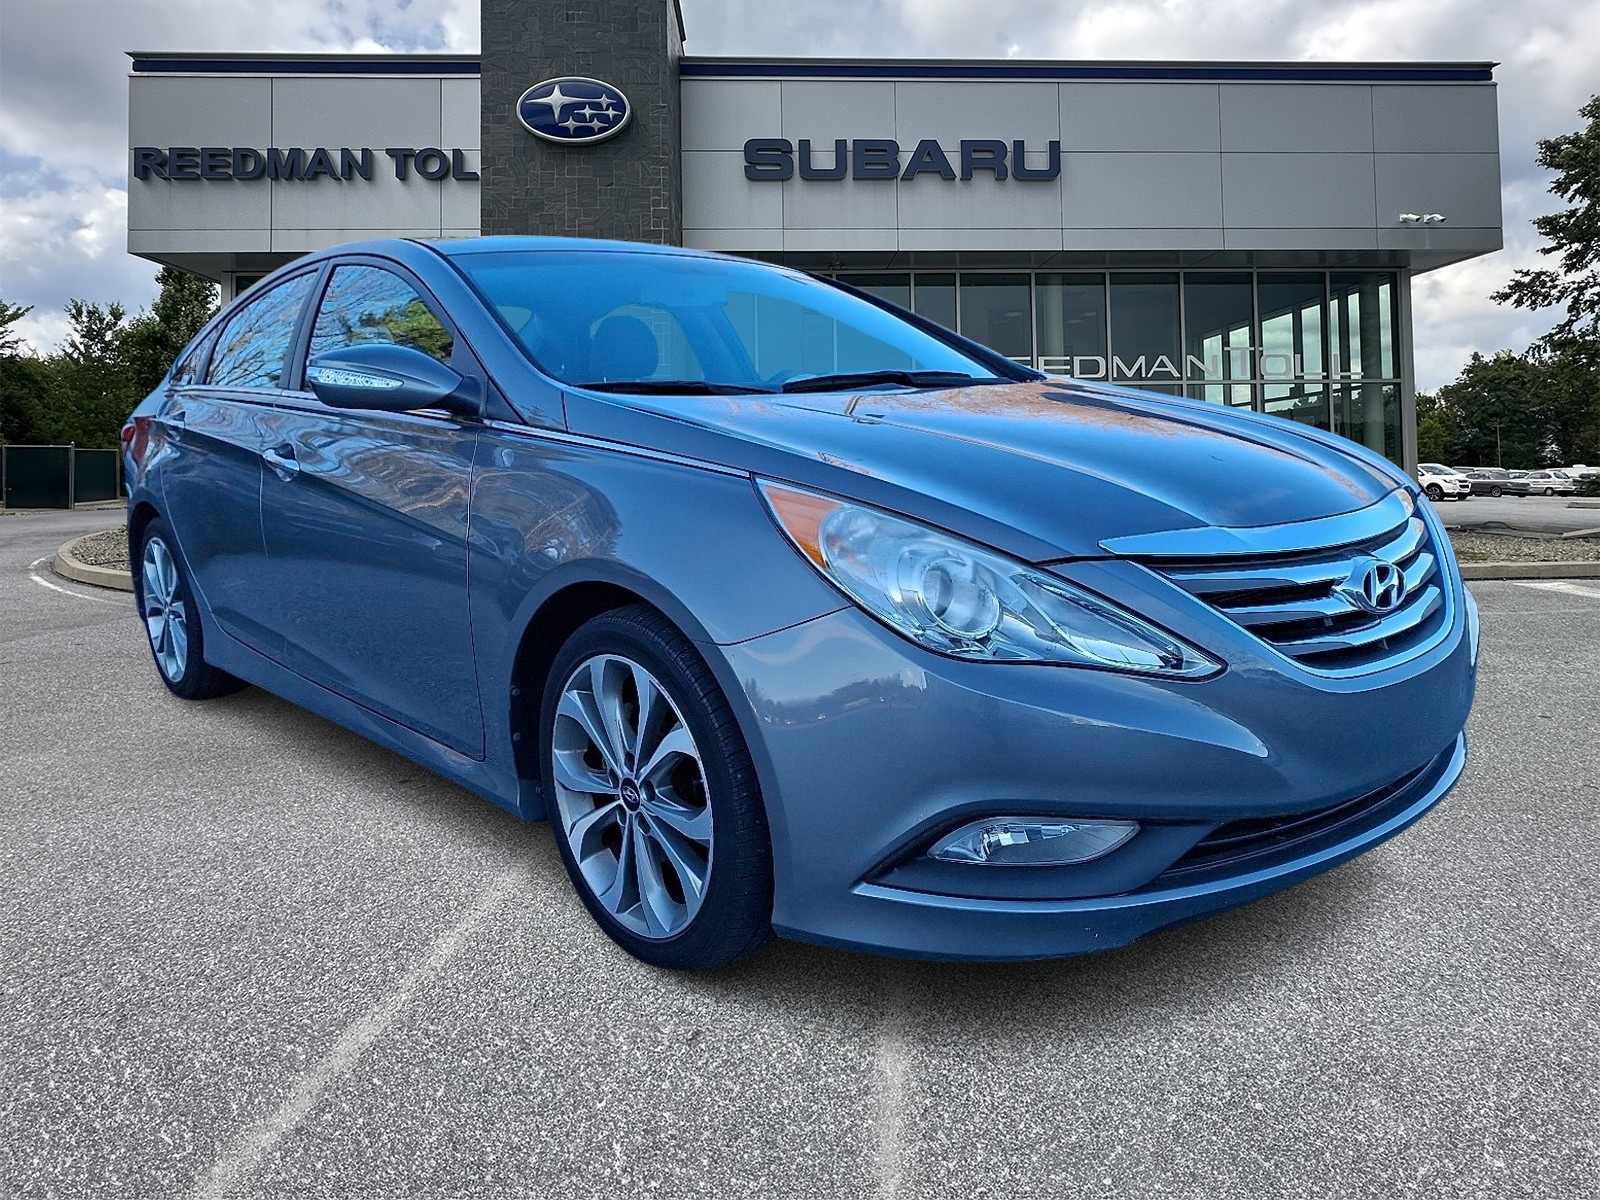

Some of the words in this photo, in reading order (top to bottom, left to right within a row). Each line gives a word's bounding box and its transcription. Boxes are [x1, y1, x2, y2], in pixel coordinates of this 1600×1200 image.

[133, 147, 373, 182] REEDMAN
[385, 147, 480, 182] TOL
[743, 138, 1062, 182] SUBARU
[1223, 346, 1365, 377] TOLL
